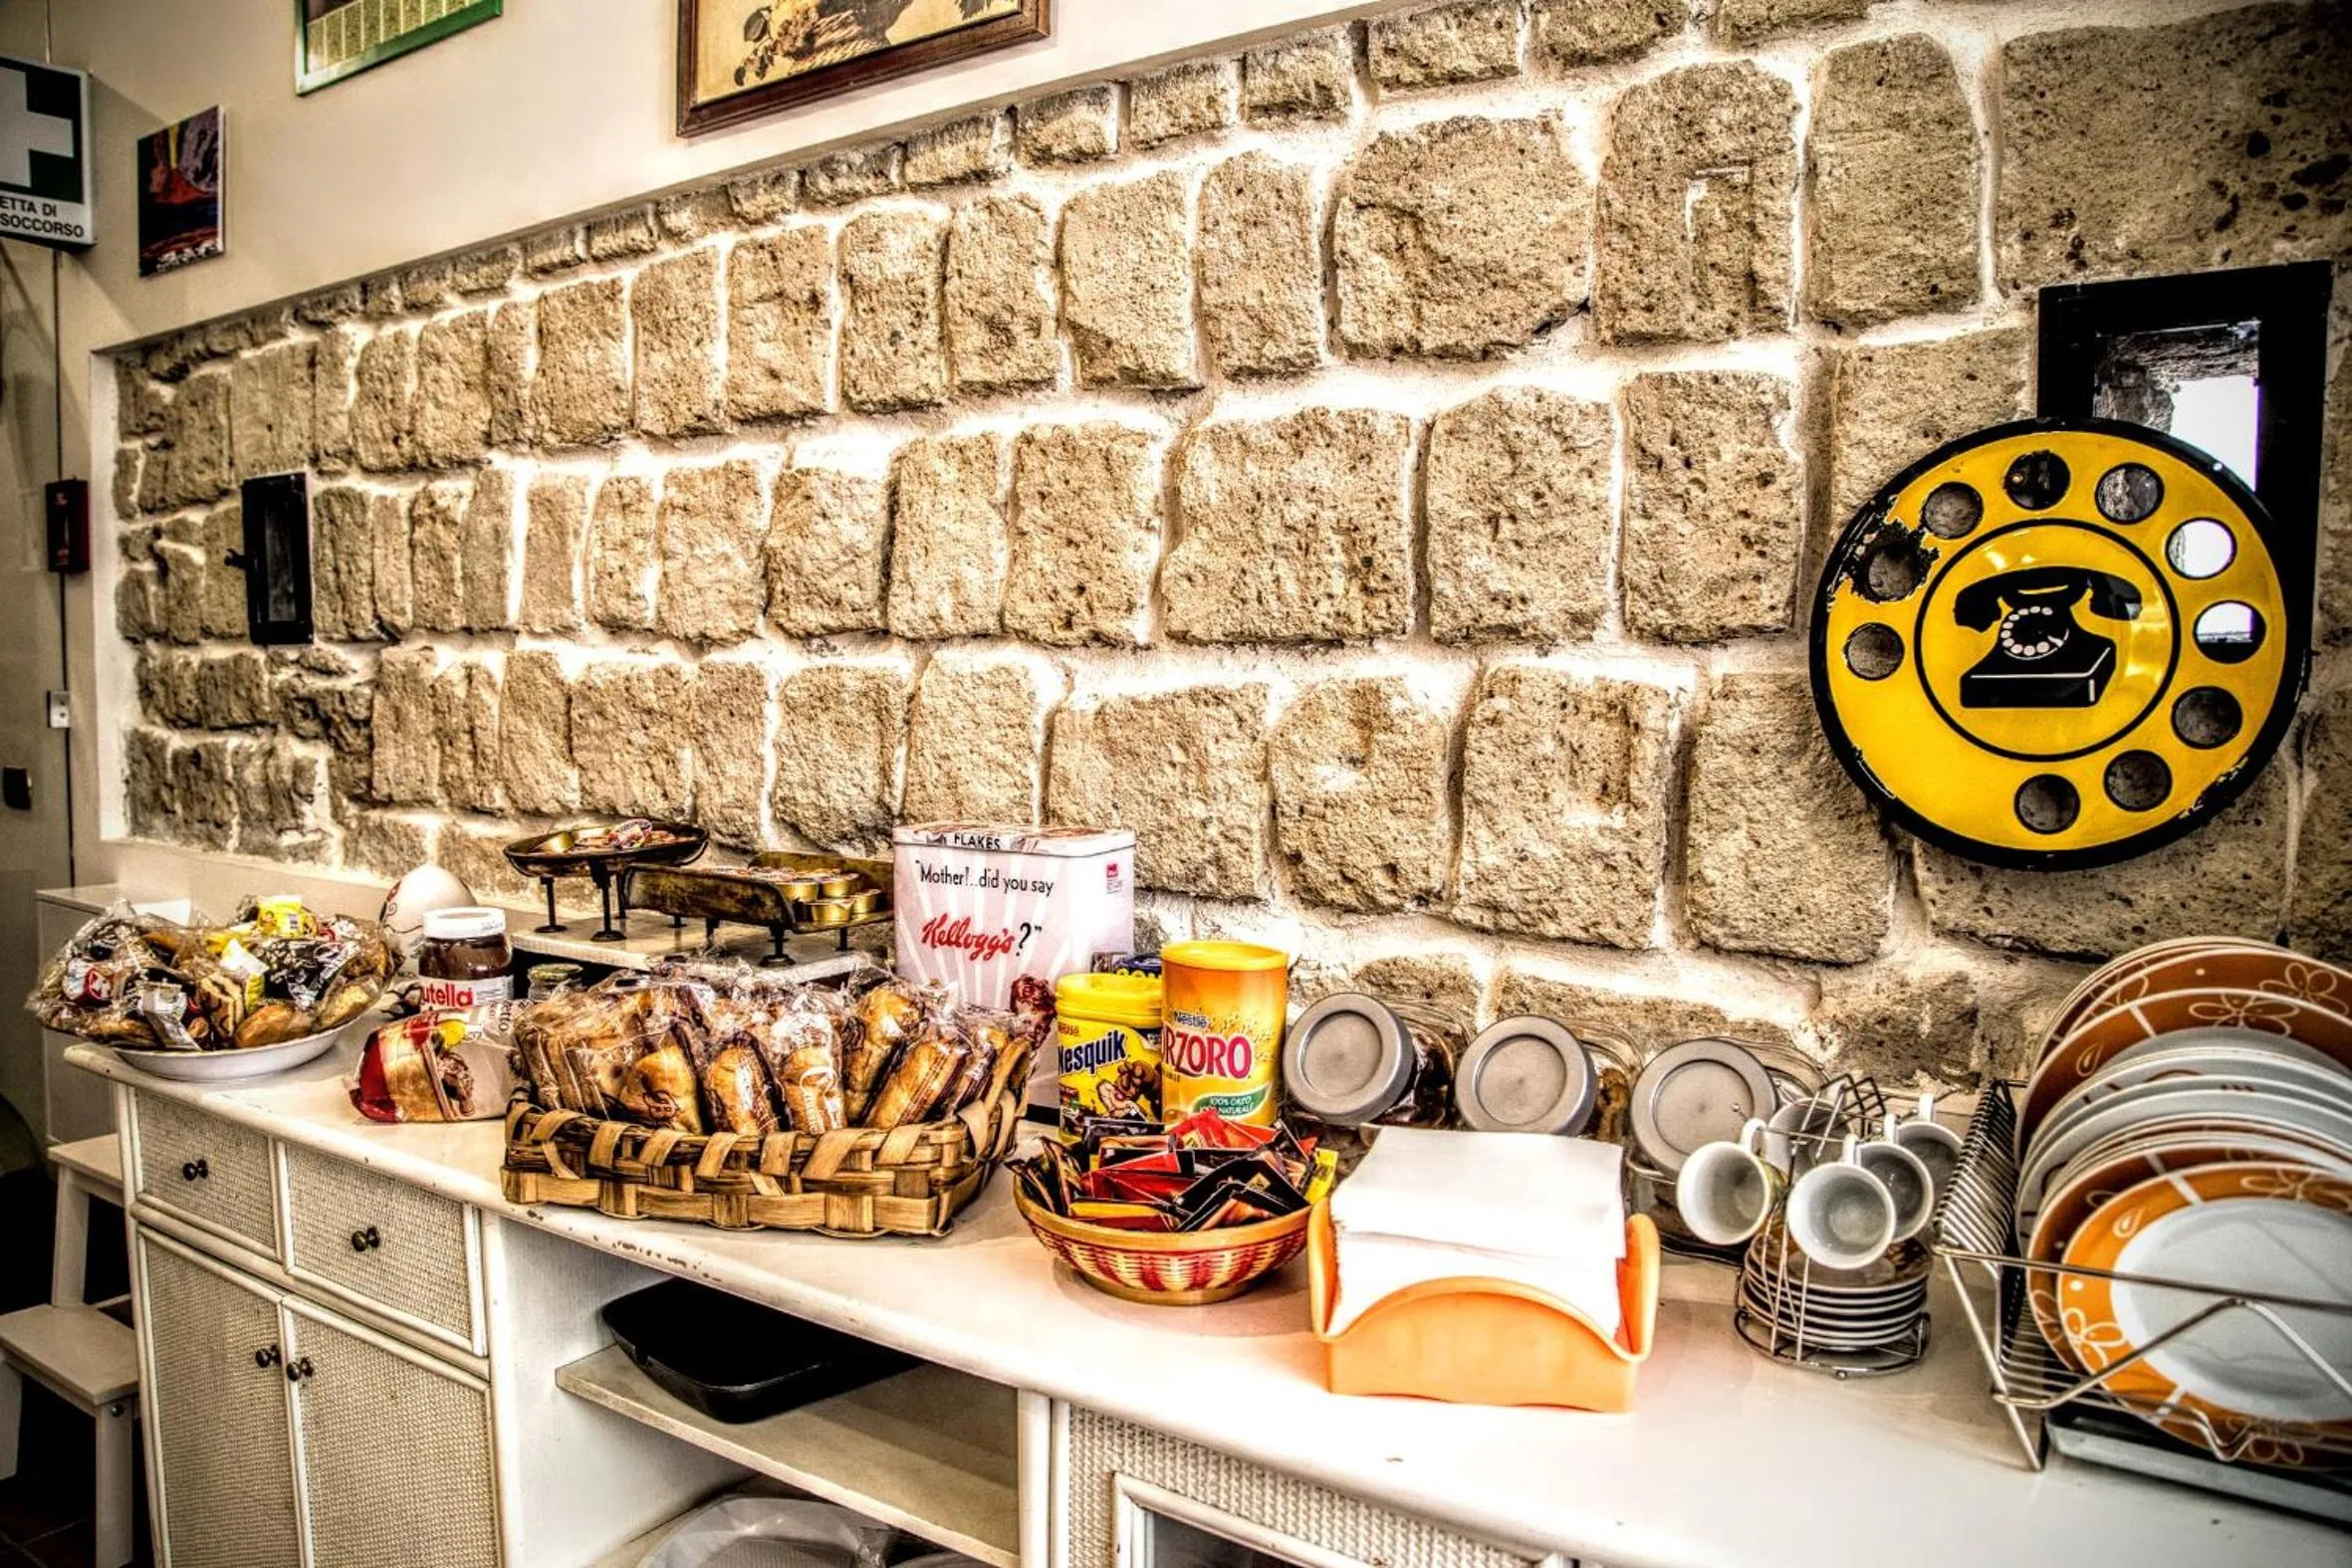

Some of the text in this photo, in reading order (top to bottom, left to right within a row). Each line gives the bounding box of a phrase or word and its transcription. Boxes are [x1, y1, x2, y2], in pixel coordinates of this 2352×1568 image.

[42, 203, 57, 217] DI
[0, 212, 85, 238] SOCCORSO
[954, 833, 1001, 850] FLAKES
[1004, 876, 1028, 894] you
[1031, 880, 1055, 897] say
[420, 983, 473, 1007] utella
[1058, 1029, 1126, 1075] Nesquik
